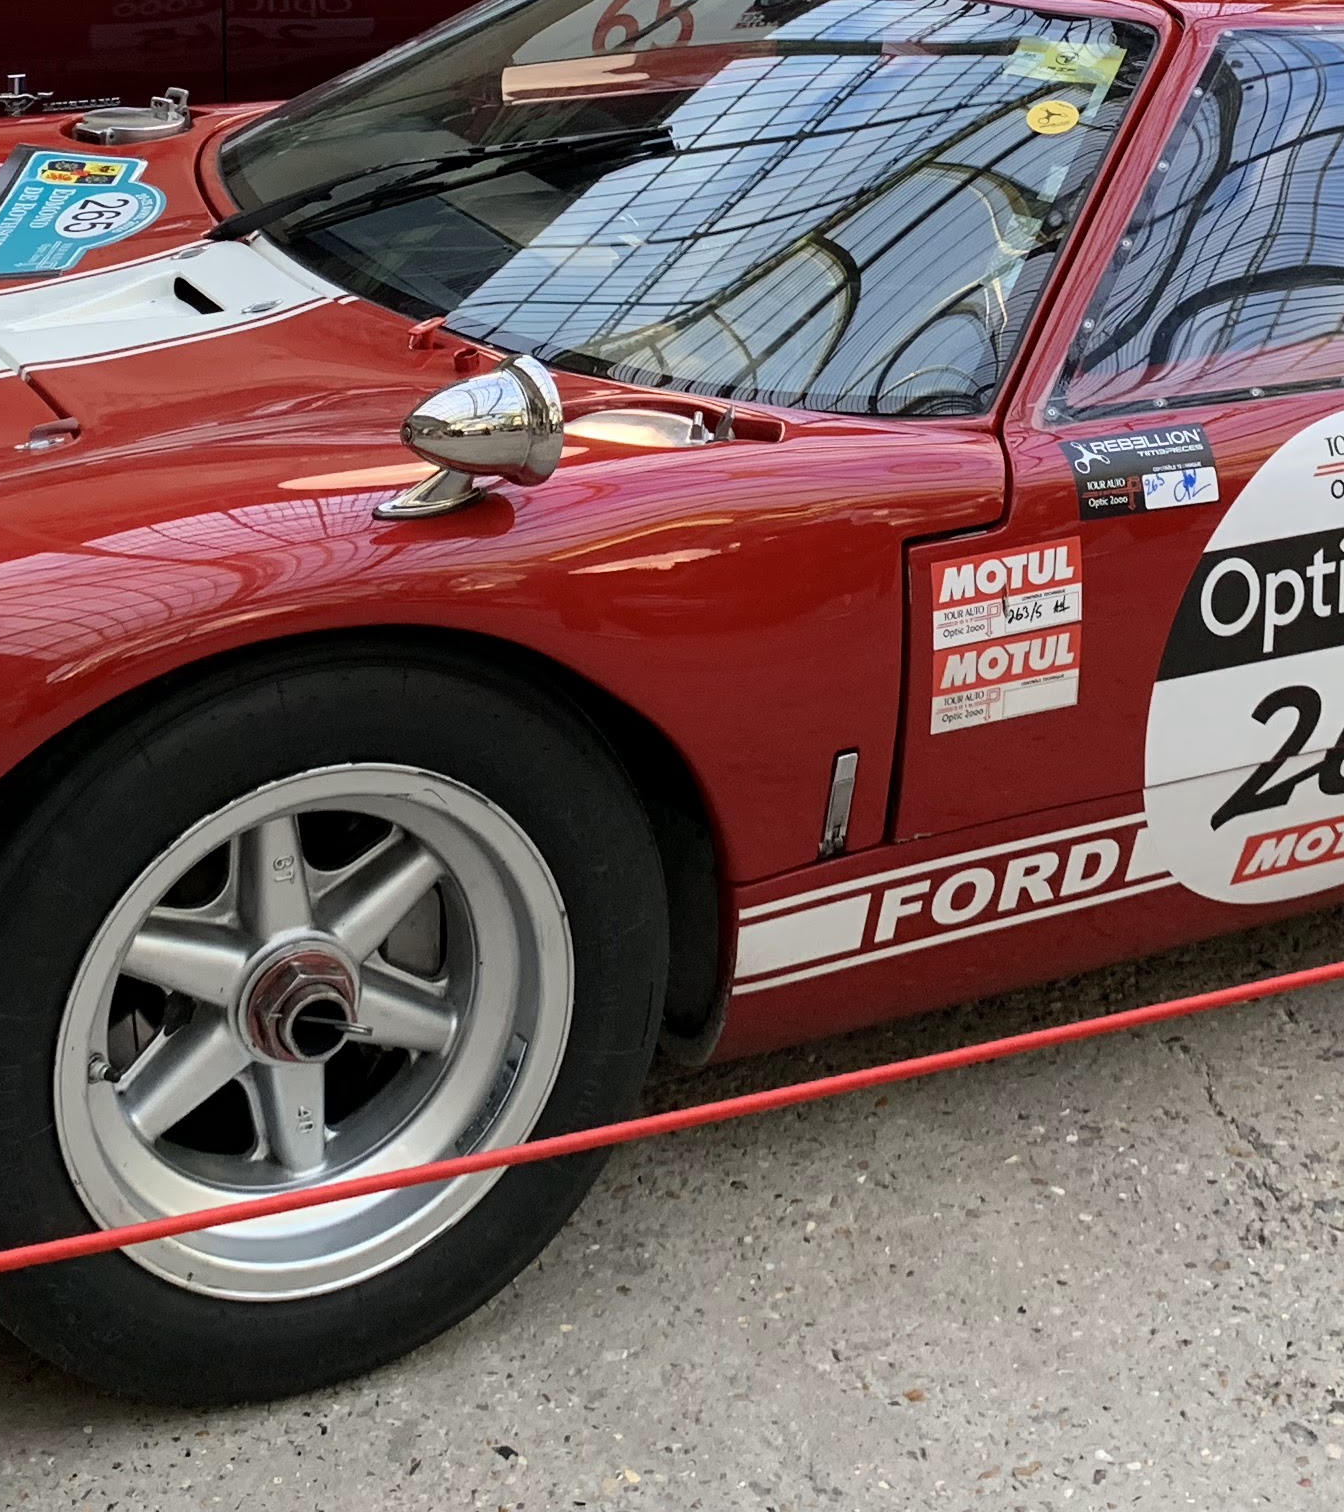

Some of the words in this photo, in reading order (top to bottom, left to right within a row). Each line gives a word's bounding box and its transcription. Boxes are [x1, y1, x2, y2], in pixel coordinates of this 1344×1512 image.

[18, 186, 44, 202] DE
[29, 188, 77, 229] EDMOND
[63, 199, 129, 233] 265
[1090, 428, 1201, 454] REBELLION
[1086, 479, 1106, 491] TOUR
[1106, 477, 1126, 489] AUTO
[1088, 496, 1108, 509] Optic
[1110, 496, 1128, 505] 2000
[939, 546, 1075, 604] MOTUL
[943, 607, 964, 621] TOUR
[965, 604, 985, 618] AUTO
[942, 627, 964, 640] Optic
[965, 623, 985, 634] 2000
[940, 633, 1075, 689] MOTUL
[944, 693, 964, 707] TOUR
[965, 690, 985, 703] AUTO
[942, 711, 964, 724] Optic
[965, 707, 985, 719] 2000
[873, 838, 1121, 944] FORD
